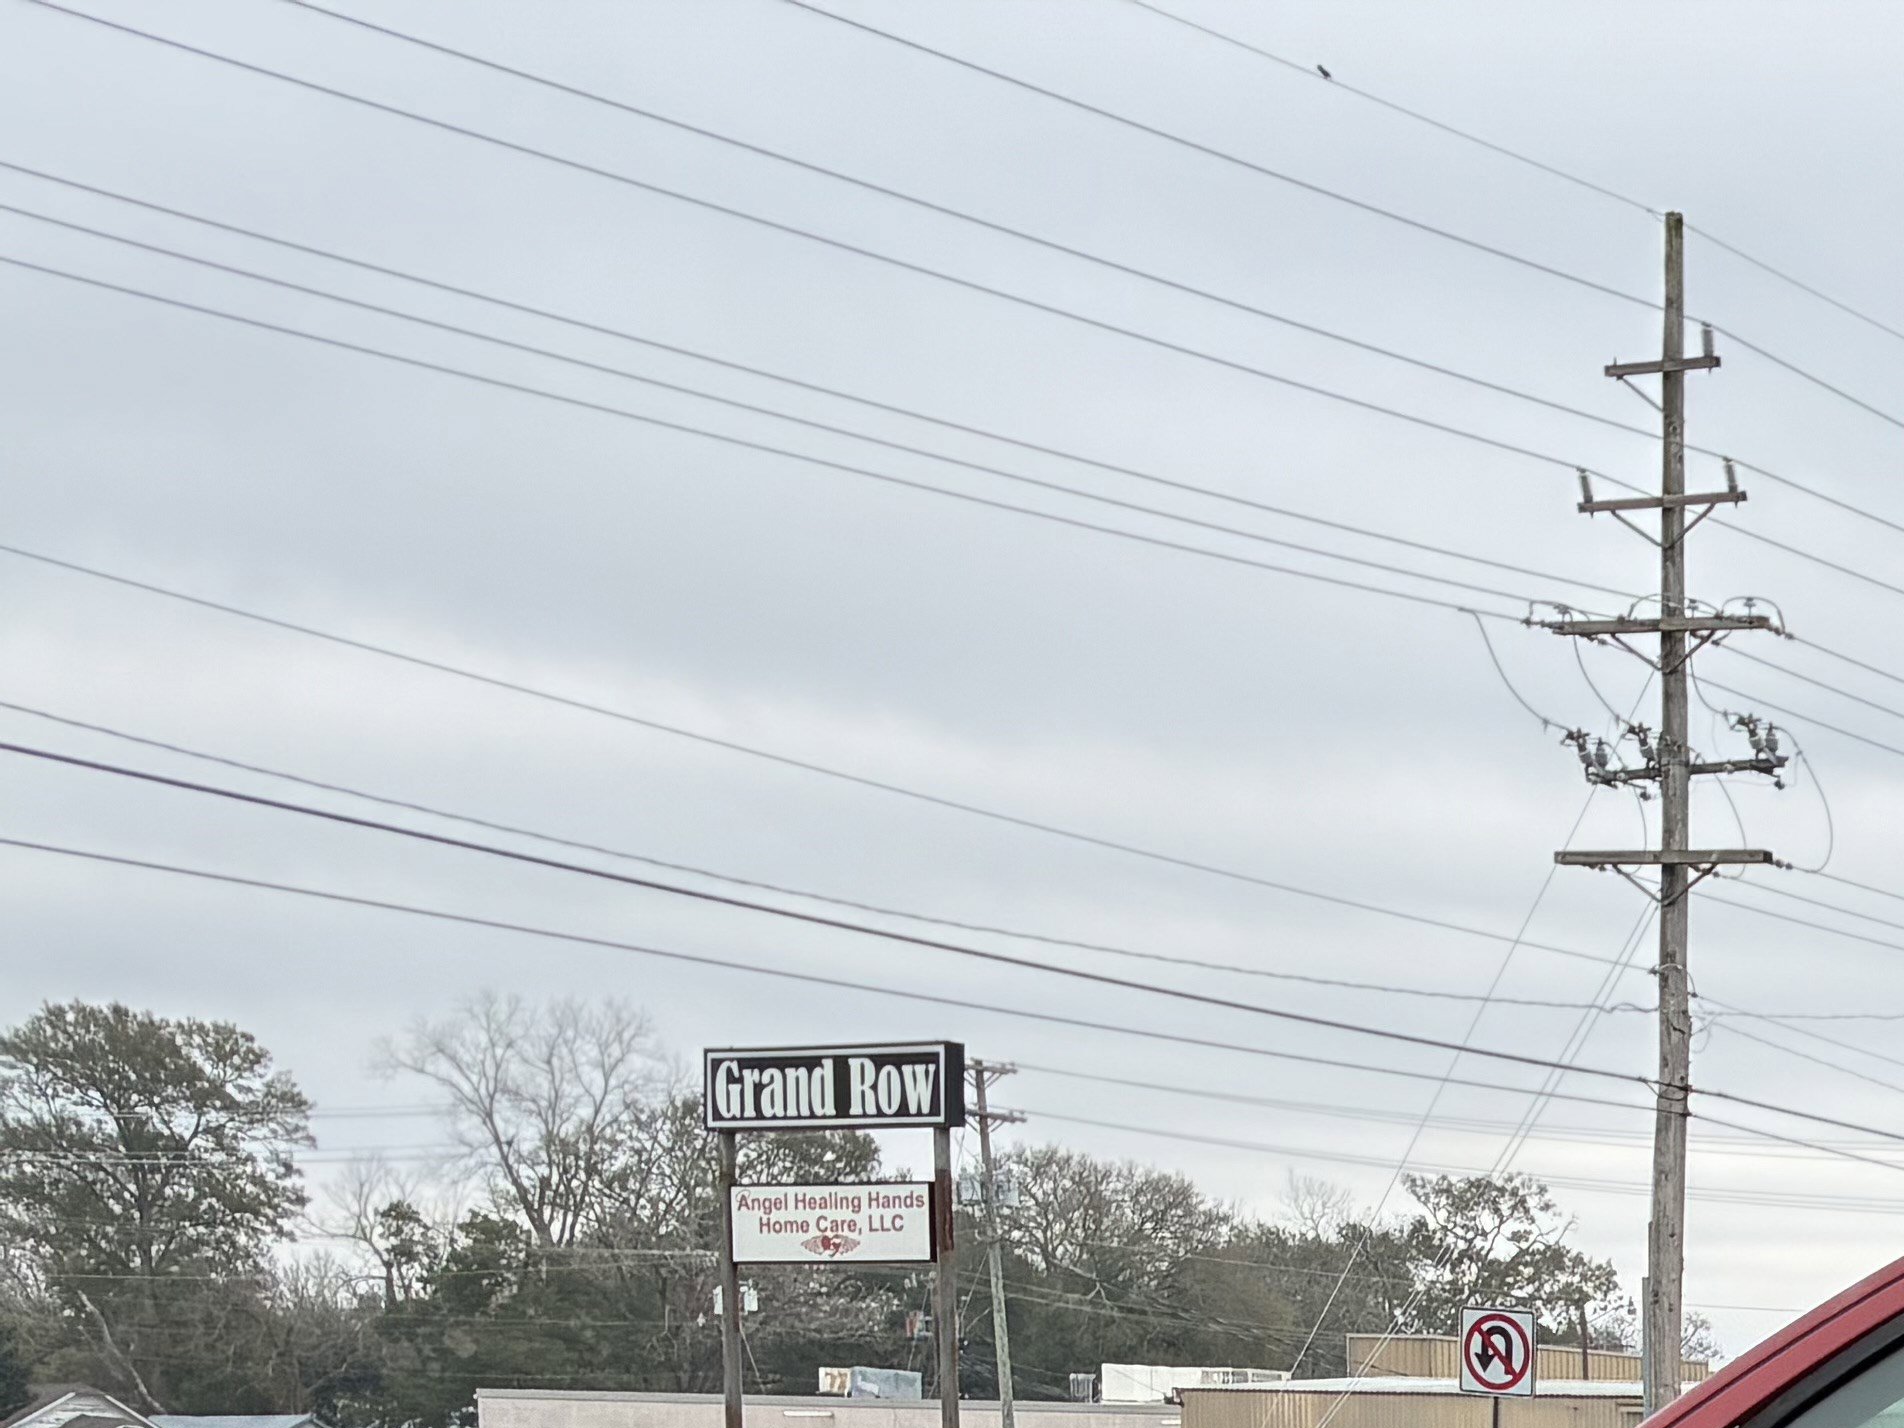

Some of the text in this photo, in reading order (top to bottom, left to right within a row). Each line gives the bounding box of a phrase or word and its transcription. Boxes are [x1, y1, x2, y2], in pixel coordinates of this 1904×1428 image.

[714, 1057, 936, 1119] Grand Row
[737, 1190, 925, 1215] Angel Healing Hands
[758, 1214, 905, 1236] Home Care, LLC
